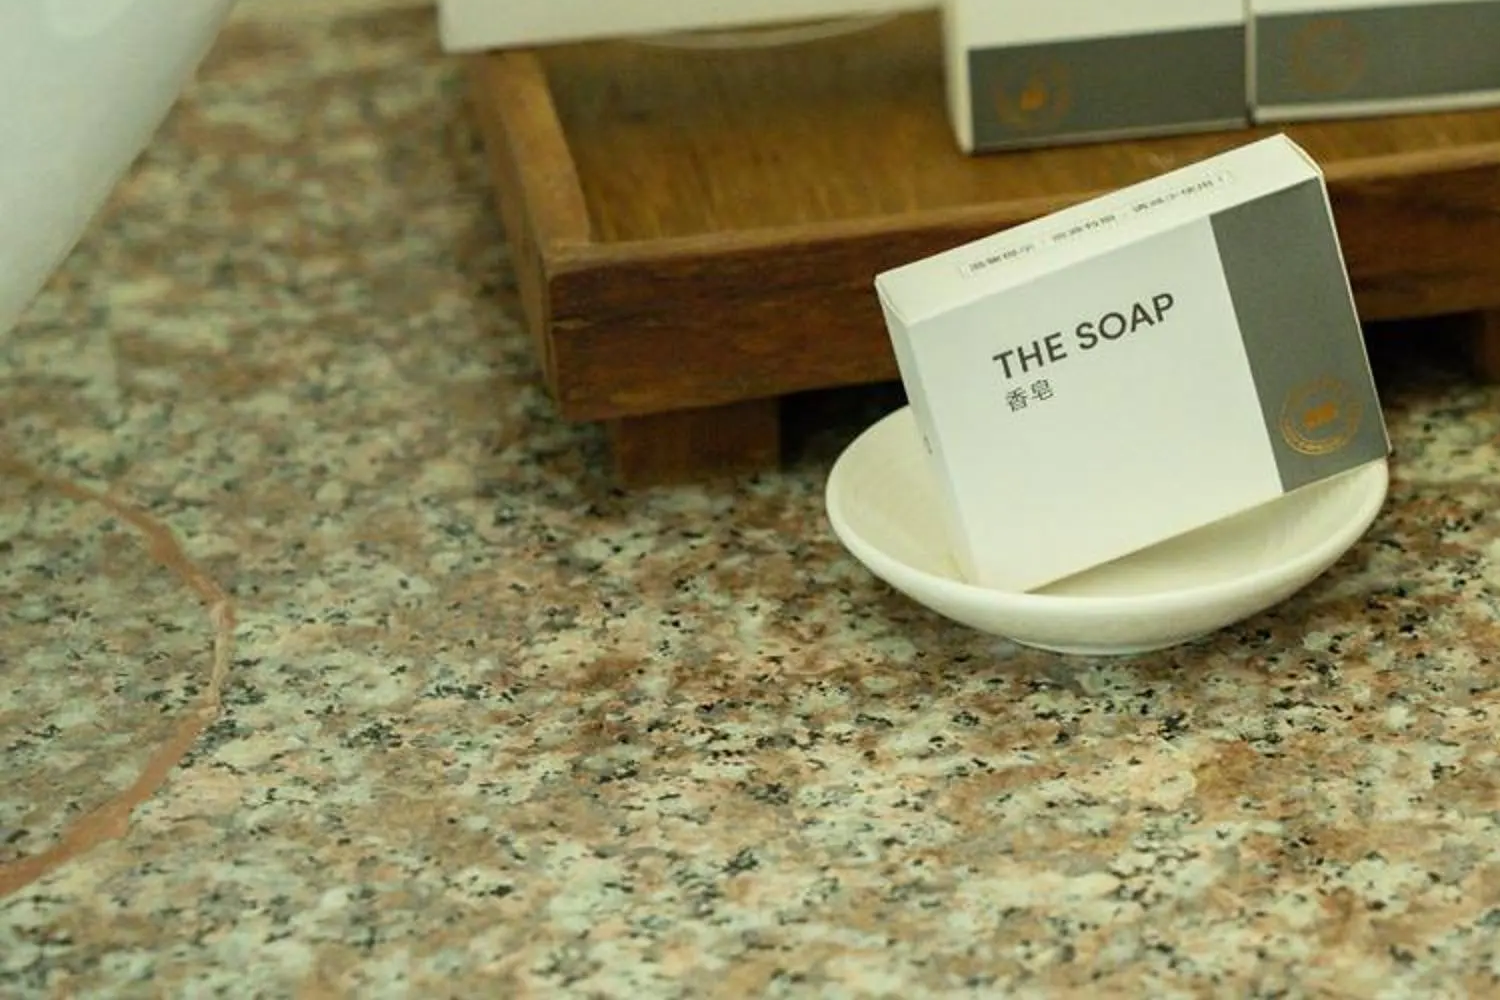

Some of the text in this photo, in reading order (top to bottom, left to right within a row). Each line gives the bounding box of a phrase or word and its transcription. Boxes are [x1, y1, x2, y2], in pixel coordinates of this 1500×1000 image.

[992, 292, 1175, 379] THE SOAP
[1007, 378, 1055, 412] 香皂
